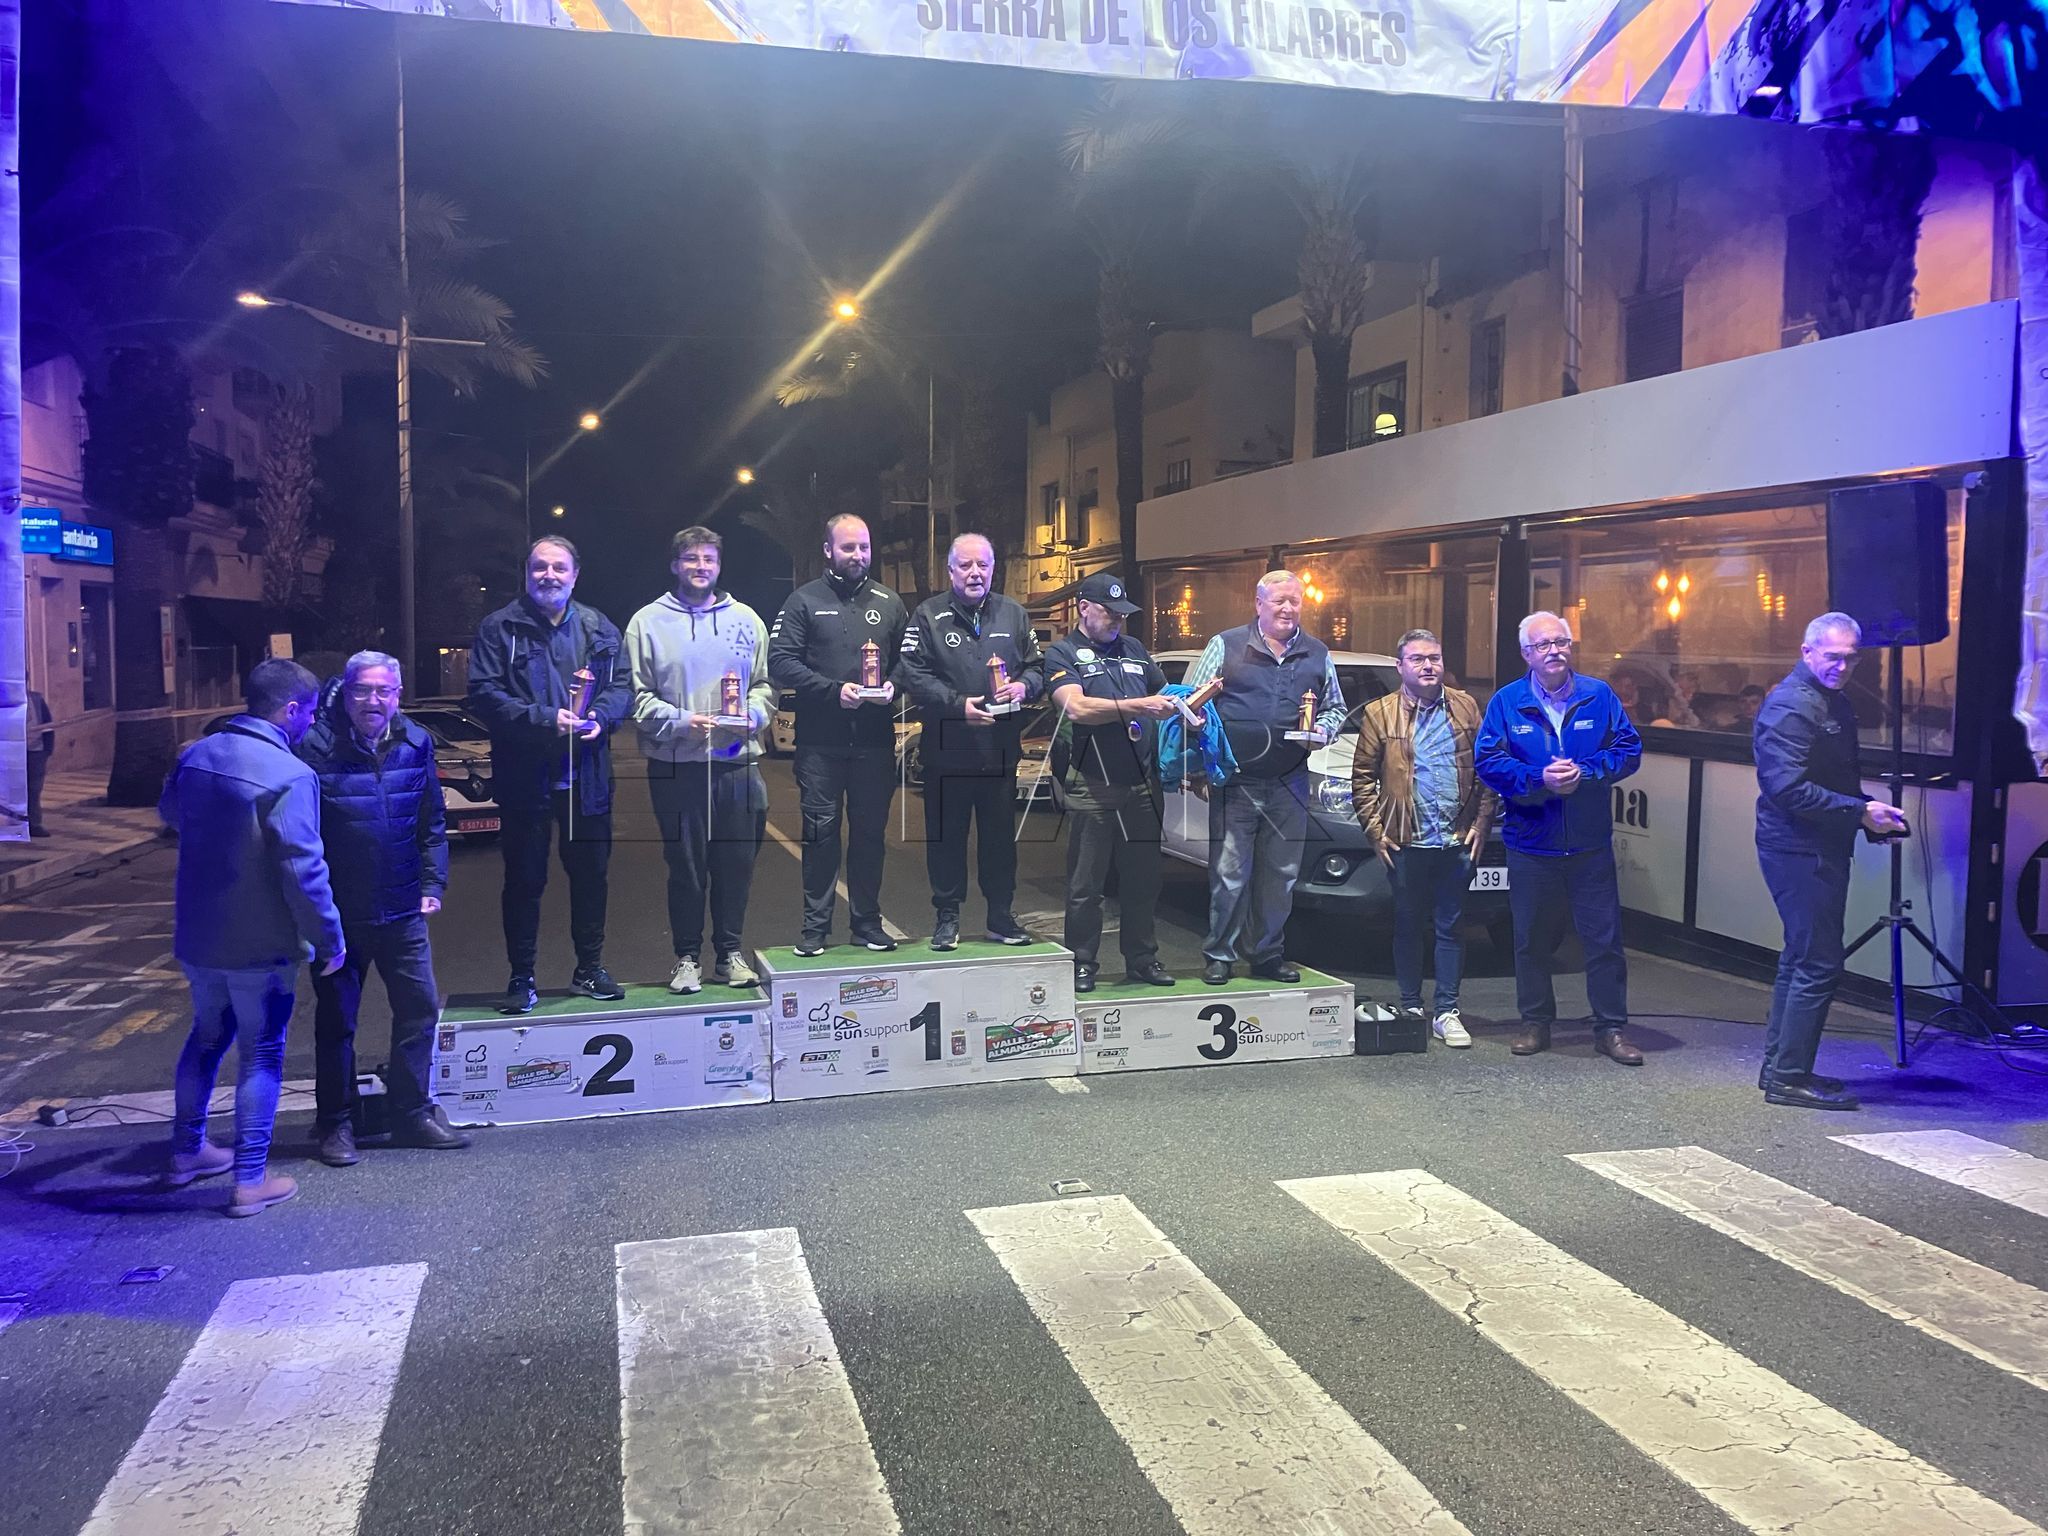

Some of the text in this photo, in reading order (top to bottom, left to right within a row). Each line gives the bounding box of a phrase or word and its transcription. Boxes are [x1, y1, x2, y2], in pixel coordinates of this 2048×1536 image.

[916, 0, 1407, 67] SIERRA DE LOS FILABRES
[834, 1029, 862, 1041] sun
[864, 1022, 910, 1039] support
[909, 1001, 942, 1060] 1
[1197, 1003, 1238, 1060] 3
[1239, 1031, 1305, 1045] sun support
[988, 1038, 1055, 1059] ALMANZORA
[992, 1036, 1026, 1049] VALLE
[582, 1033, 635, 1097] 2
[708, 1064, 744, 1073] Greening
